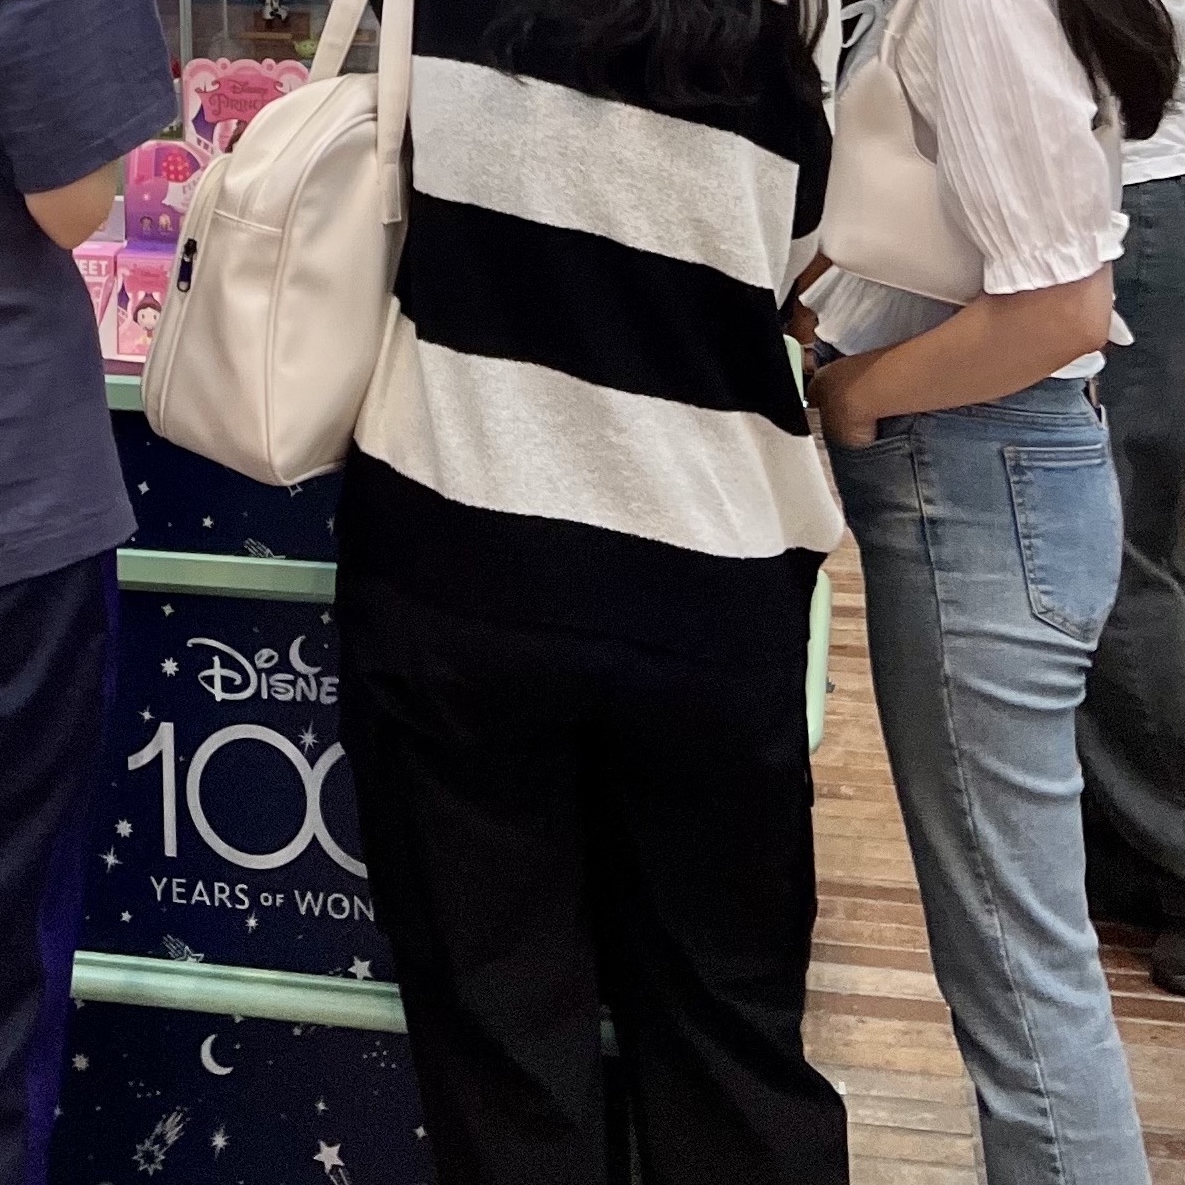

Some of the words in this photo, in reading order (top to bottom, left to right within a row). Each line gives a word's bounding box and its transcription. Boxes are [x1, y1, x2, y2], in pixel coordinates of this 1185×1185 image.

[208, 93, 269, 116] PRINC
[76, 259, 108, 276] EET
[187, 636, 340, 705] DISNE
[150, 876, 250, 911] YEARS
[260, 893, 285, 908] OF
[294, 889, 376, 923] WON
